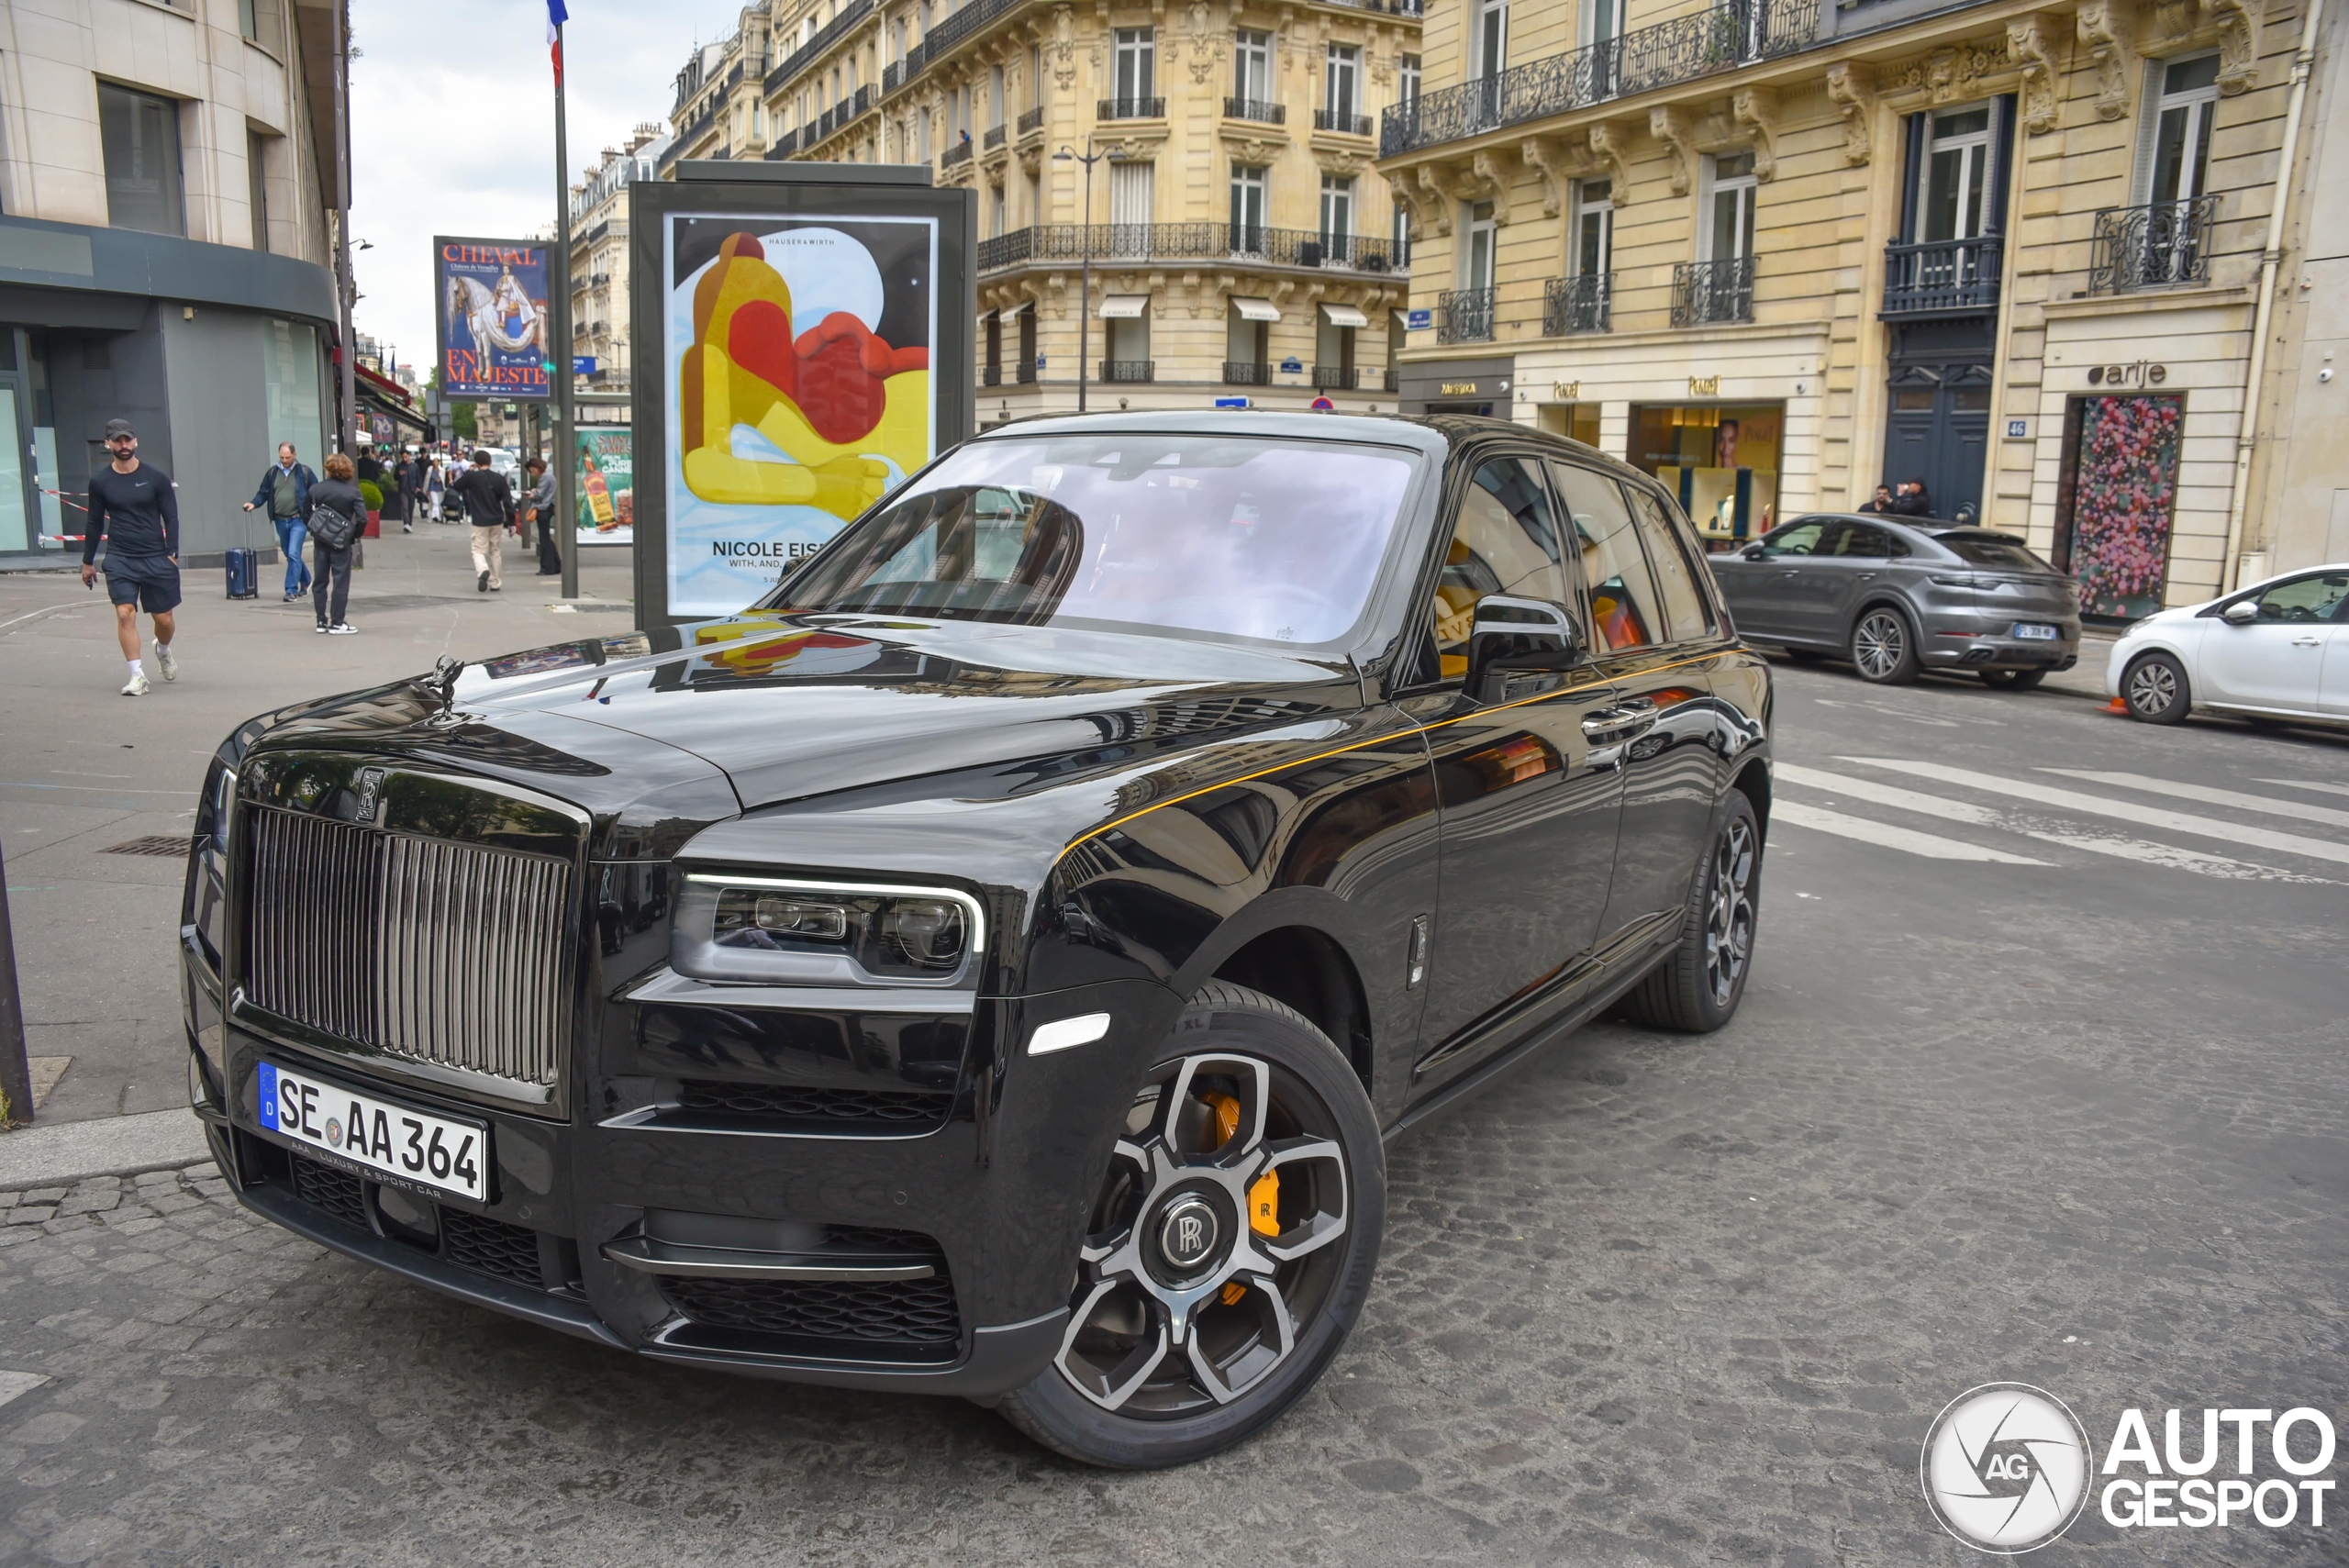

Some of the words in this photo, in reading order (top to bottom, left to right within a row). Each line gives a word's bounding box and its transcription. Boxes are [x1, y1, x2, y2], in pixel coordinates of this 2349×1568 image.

[443, 244, 537, 266] CHEVAL
[446, 349, 477, 367] EN
[447, 364, 548, 384] MAJESTÉ
[2106, 360, 2166, 389] arije
[1553, 380, 1581, 400] PIAGET
[1688, 374, 1720, 398] PIAGET
[505, 404, 518, 413] 32
[2009, 422, 2024, 436] 46
[595, 444, 632, 454] JAMES
[598, 435, 629, 445] SAINT
[608, 459, 632, 467] PURE
[713, 541, 783, 557] NICOLE
[729, 559, 757, 568] WITH,
[759, 560, 782, 569] AND,
[266, 1101, 273, 1117] D
[280, 1078, 322, 1140] SE
[346, 1101, 393, 1164] AA
[402, 1117, 477, 1189] 364
[292, 1141, 311, 1155] AAA
[319, 1152, 360, 1173] LUXURY
[363, 1168, 372, 1177] &
[374, 1171, 413, 1191] SPORT
[417, 1184, 442, 1199] CAR
[1178, 1216, 1203, 1253] RR
